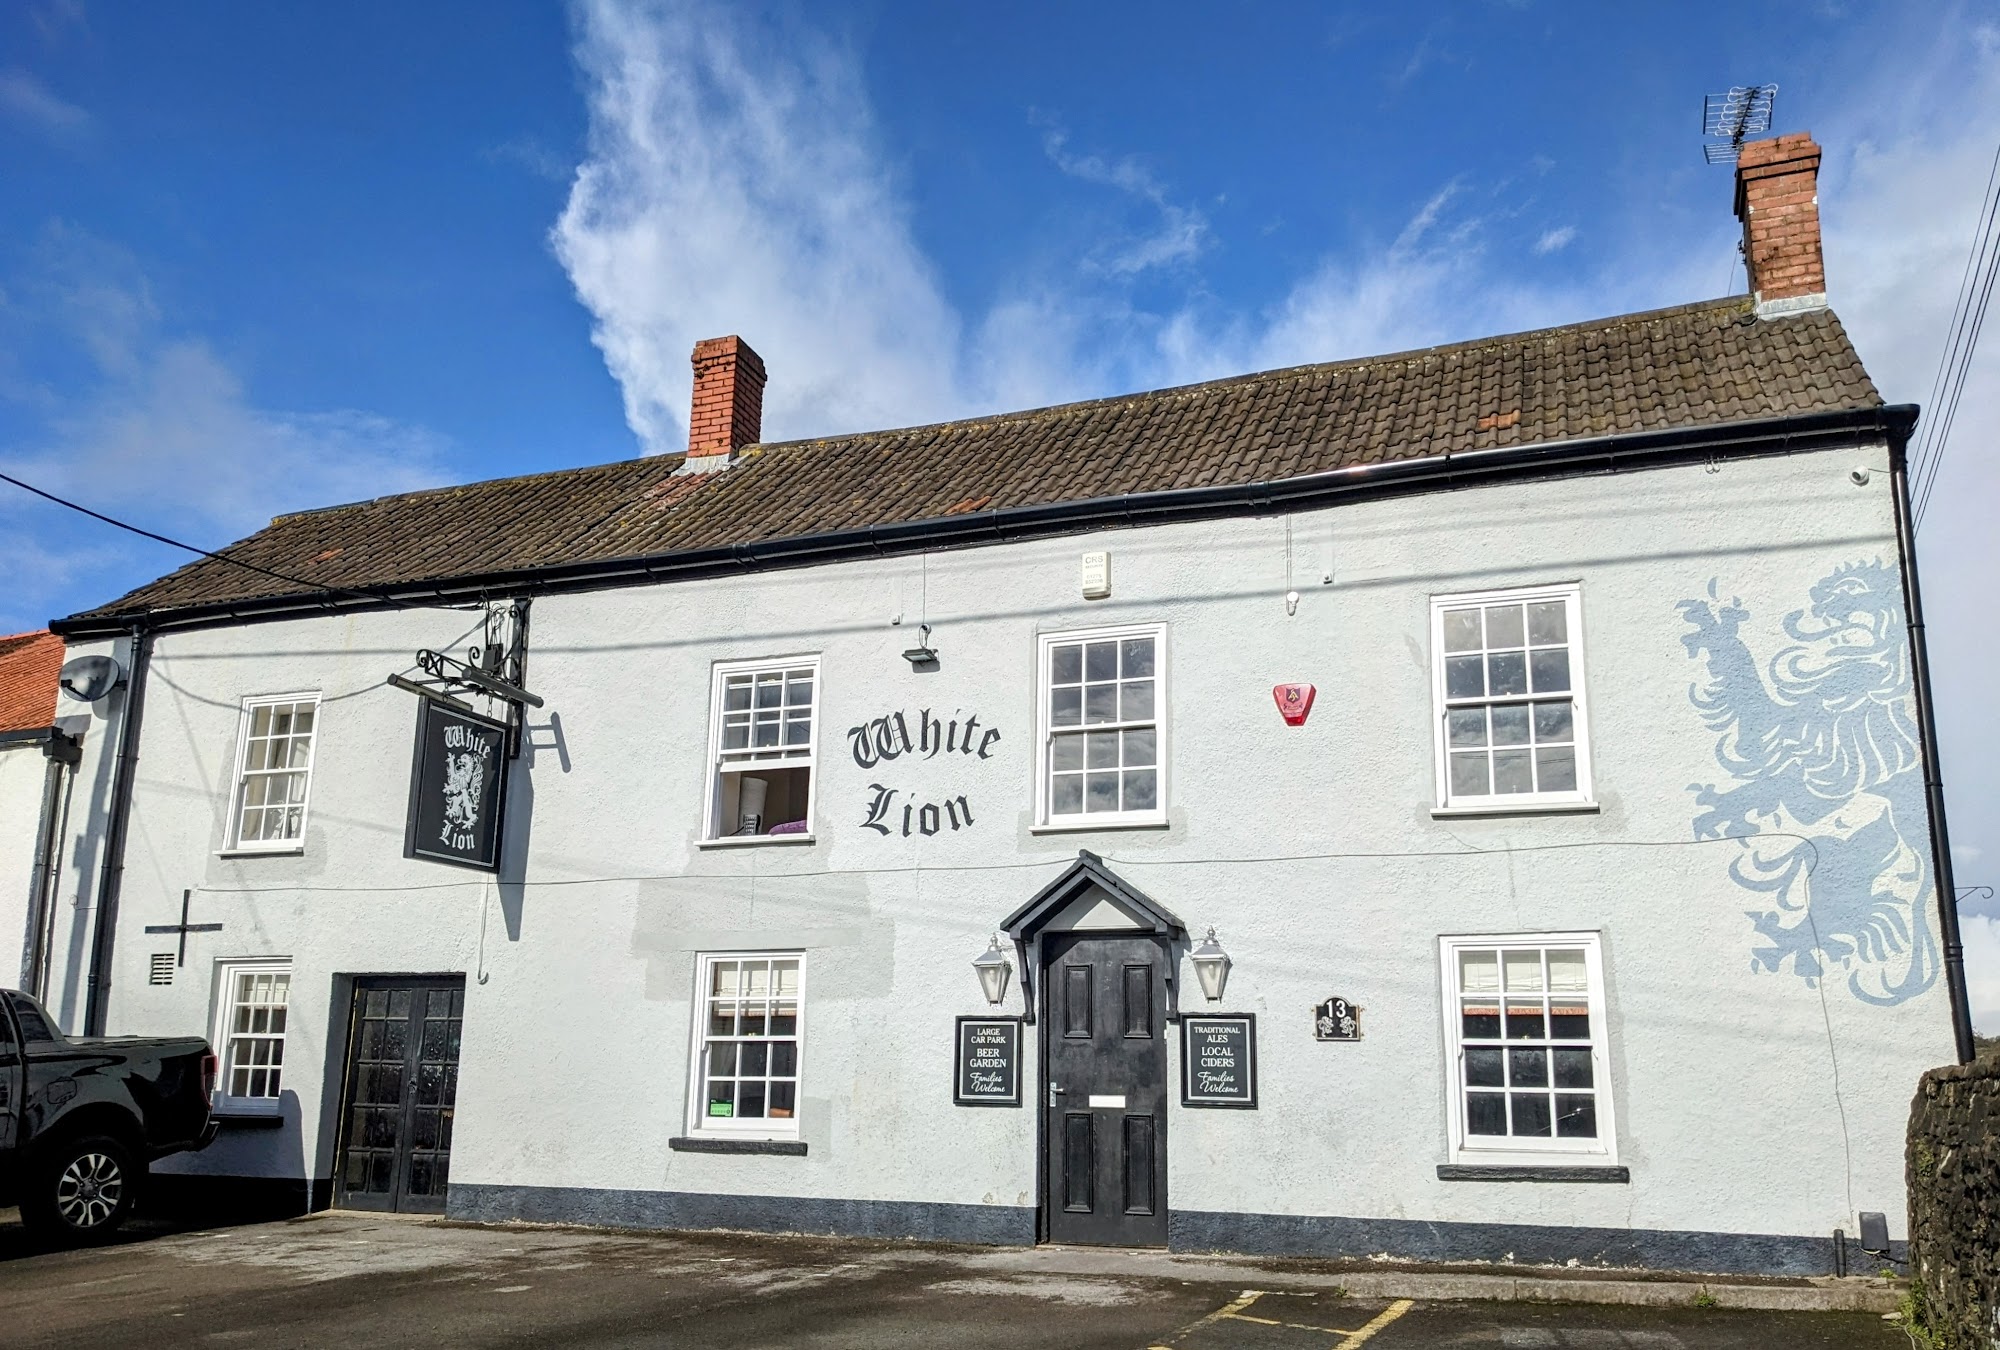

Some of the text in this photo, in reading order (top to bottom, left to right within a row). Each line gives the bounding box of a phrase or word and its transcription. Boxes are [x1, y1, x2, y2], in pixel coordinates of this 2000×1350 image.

[1085, 555, 1104, 564] CRS
[443, 725, 491, 759] White
[847, 708, 1002, 769] White
[859, 783, 976, 838] Lion
[439, 819, 475, 850] Lion
[1326, 1000, 1347, 1018] 13
[1193, 1026, 1240, 1034] TRADITIONAL
[971, 1036, 1006, 1044] CAR PARK
[1206, 1034, 1228, 1043] ALES
[976, 1048, 1000, 1057] BEER
[1201, 1046, 1234, 1056] LOCAL
[969, 1058, 1007, 1068] GARDEN
[1200, 1058, 1235, 1067] CIDERS
[969, 1071, 1002, 1082] Families
[1197, 1070, 1235, 1082] Families
[971, 1081, 1005, 1092] Welcome
[1199, 1081, 1239, 1093] Welcome
